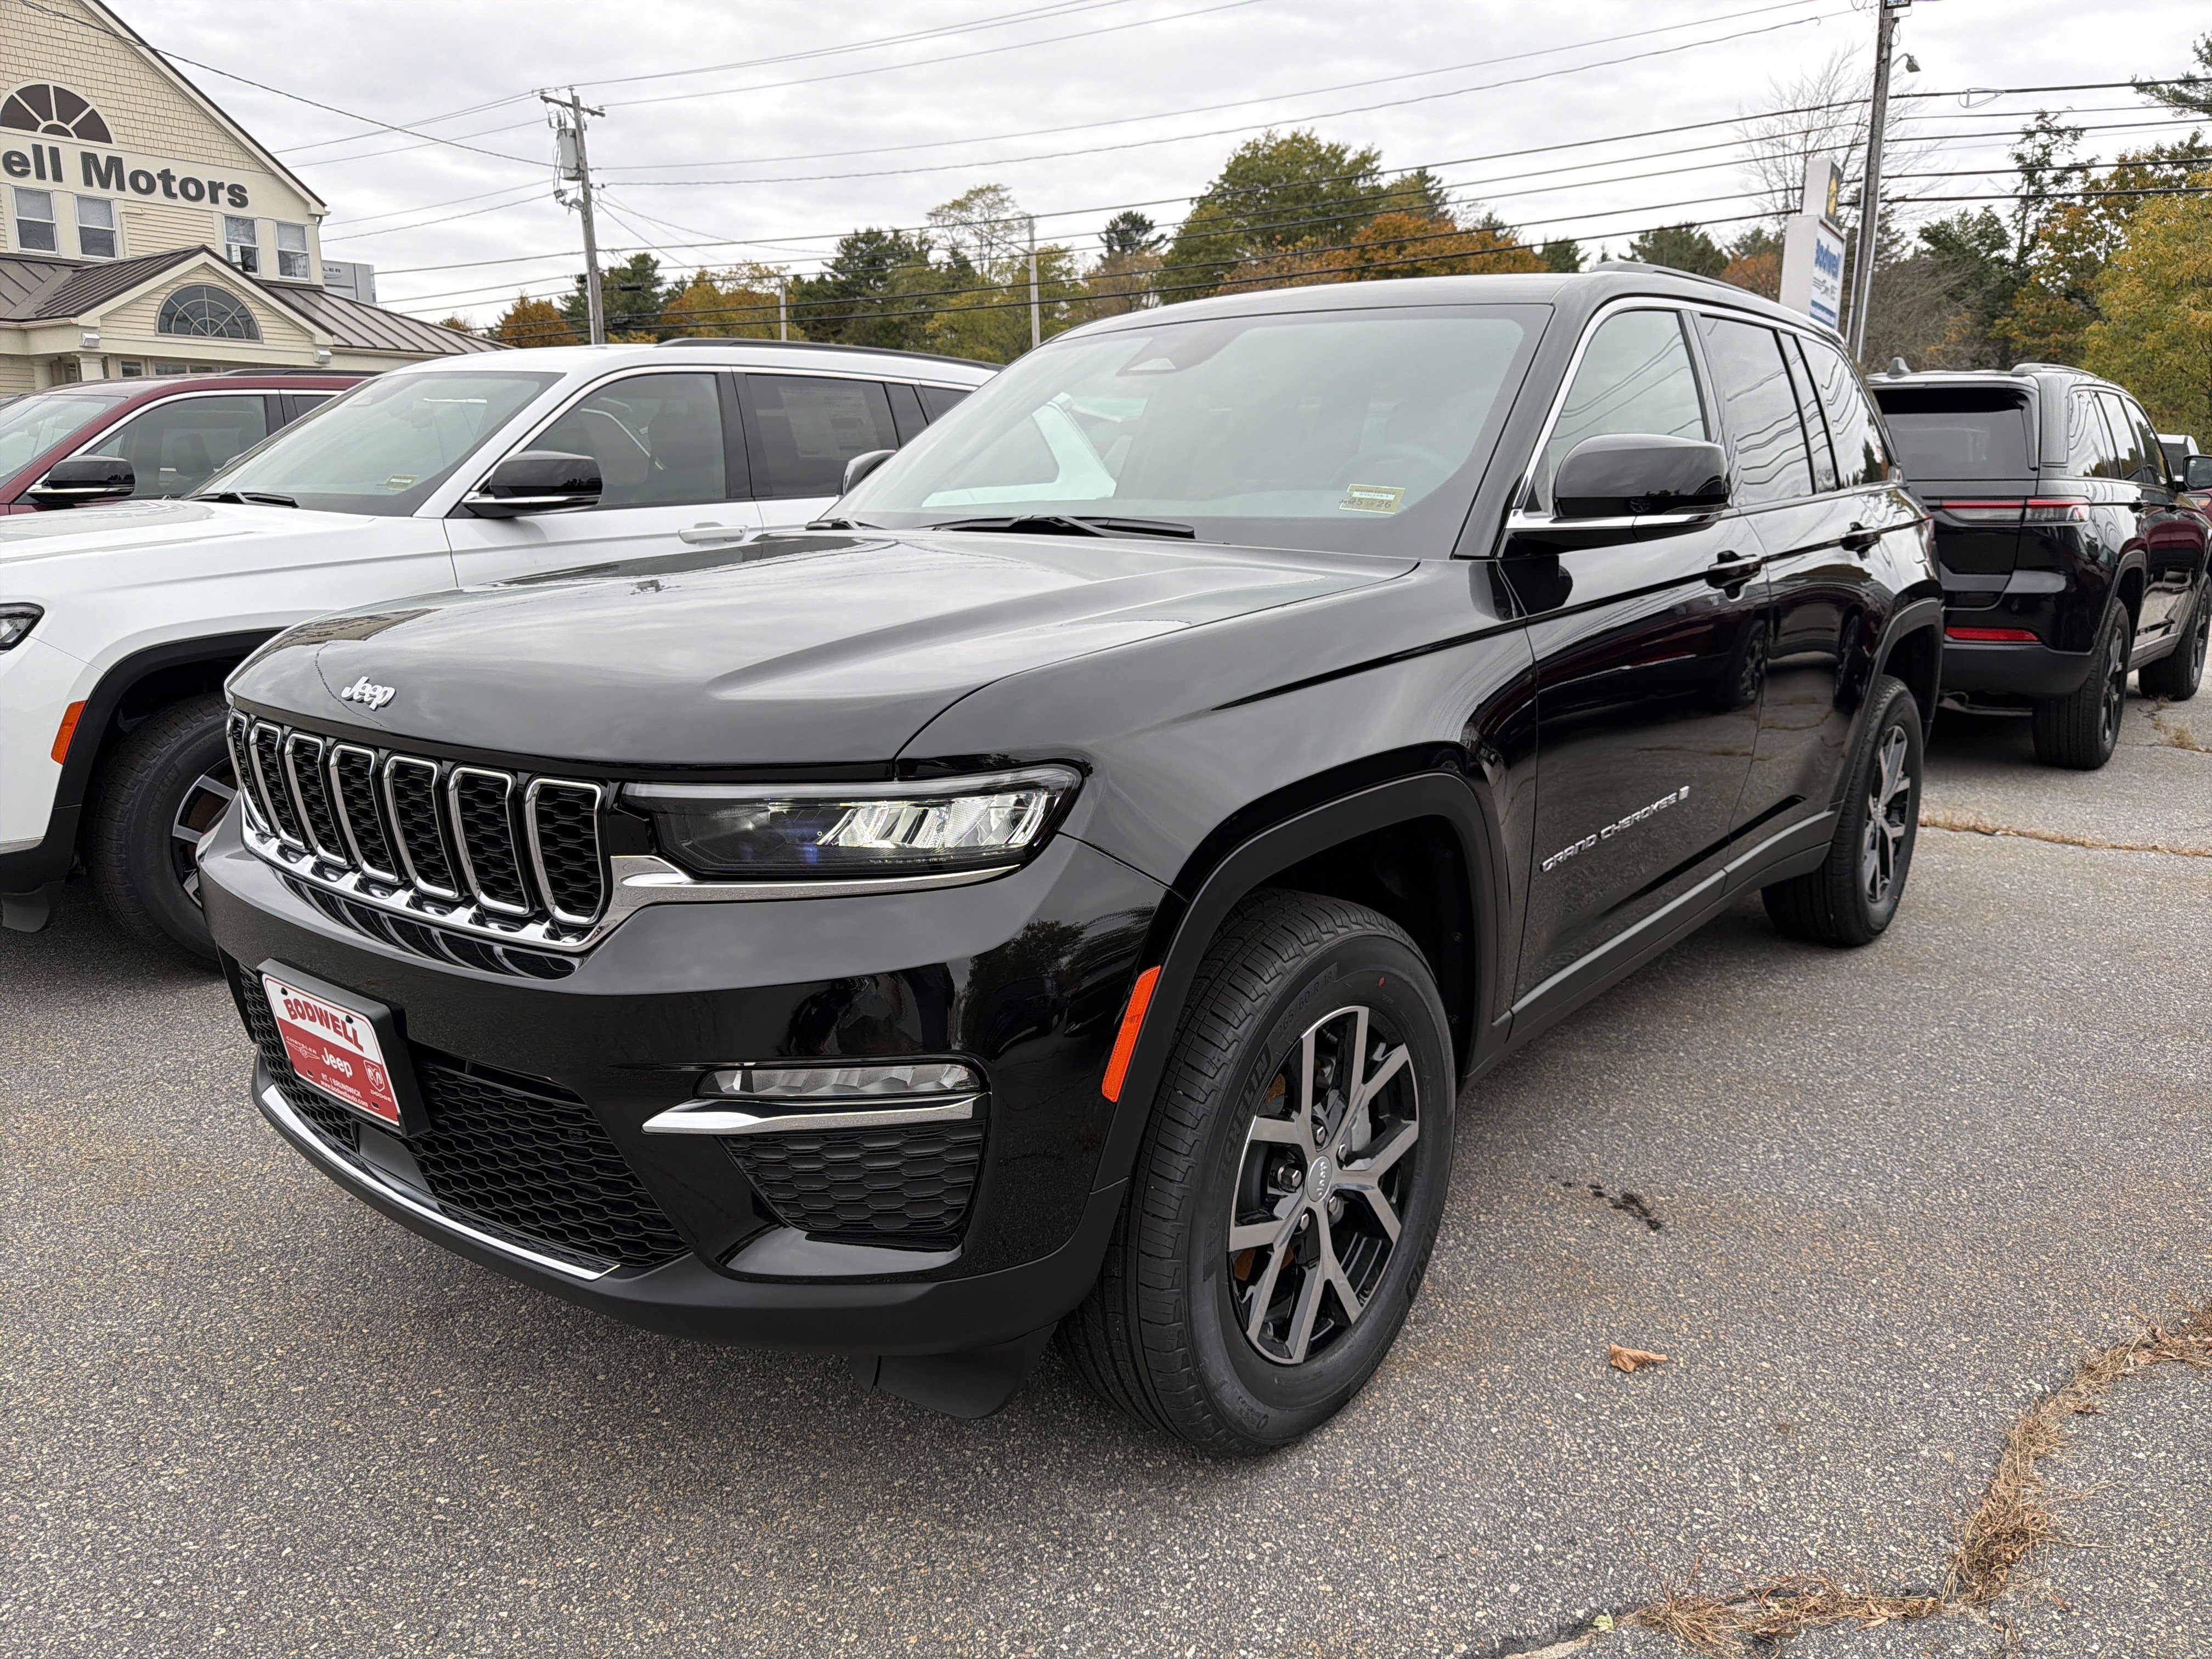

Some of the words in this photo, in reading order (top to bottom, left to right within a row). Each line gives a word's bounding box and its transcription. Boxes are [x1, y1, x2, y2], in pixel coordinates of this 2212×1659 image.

[80, 151, 250, 208] Motors
[1377, 500, 1392, 508] 26
[341, 676, 396, 712] Jeep
[1540, 834, 1597, 872] GRAND
[1598, 792, 1678, 840] CHEROKEE
[283, 998, 364, 1053] BODWELL
[286, 1036, 318, 1054] CHRYSLER
[321, 1047, 353, 1078] Jeep
[370, 1089, 392, 1103] DODGE
